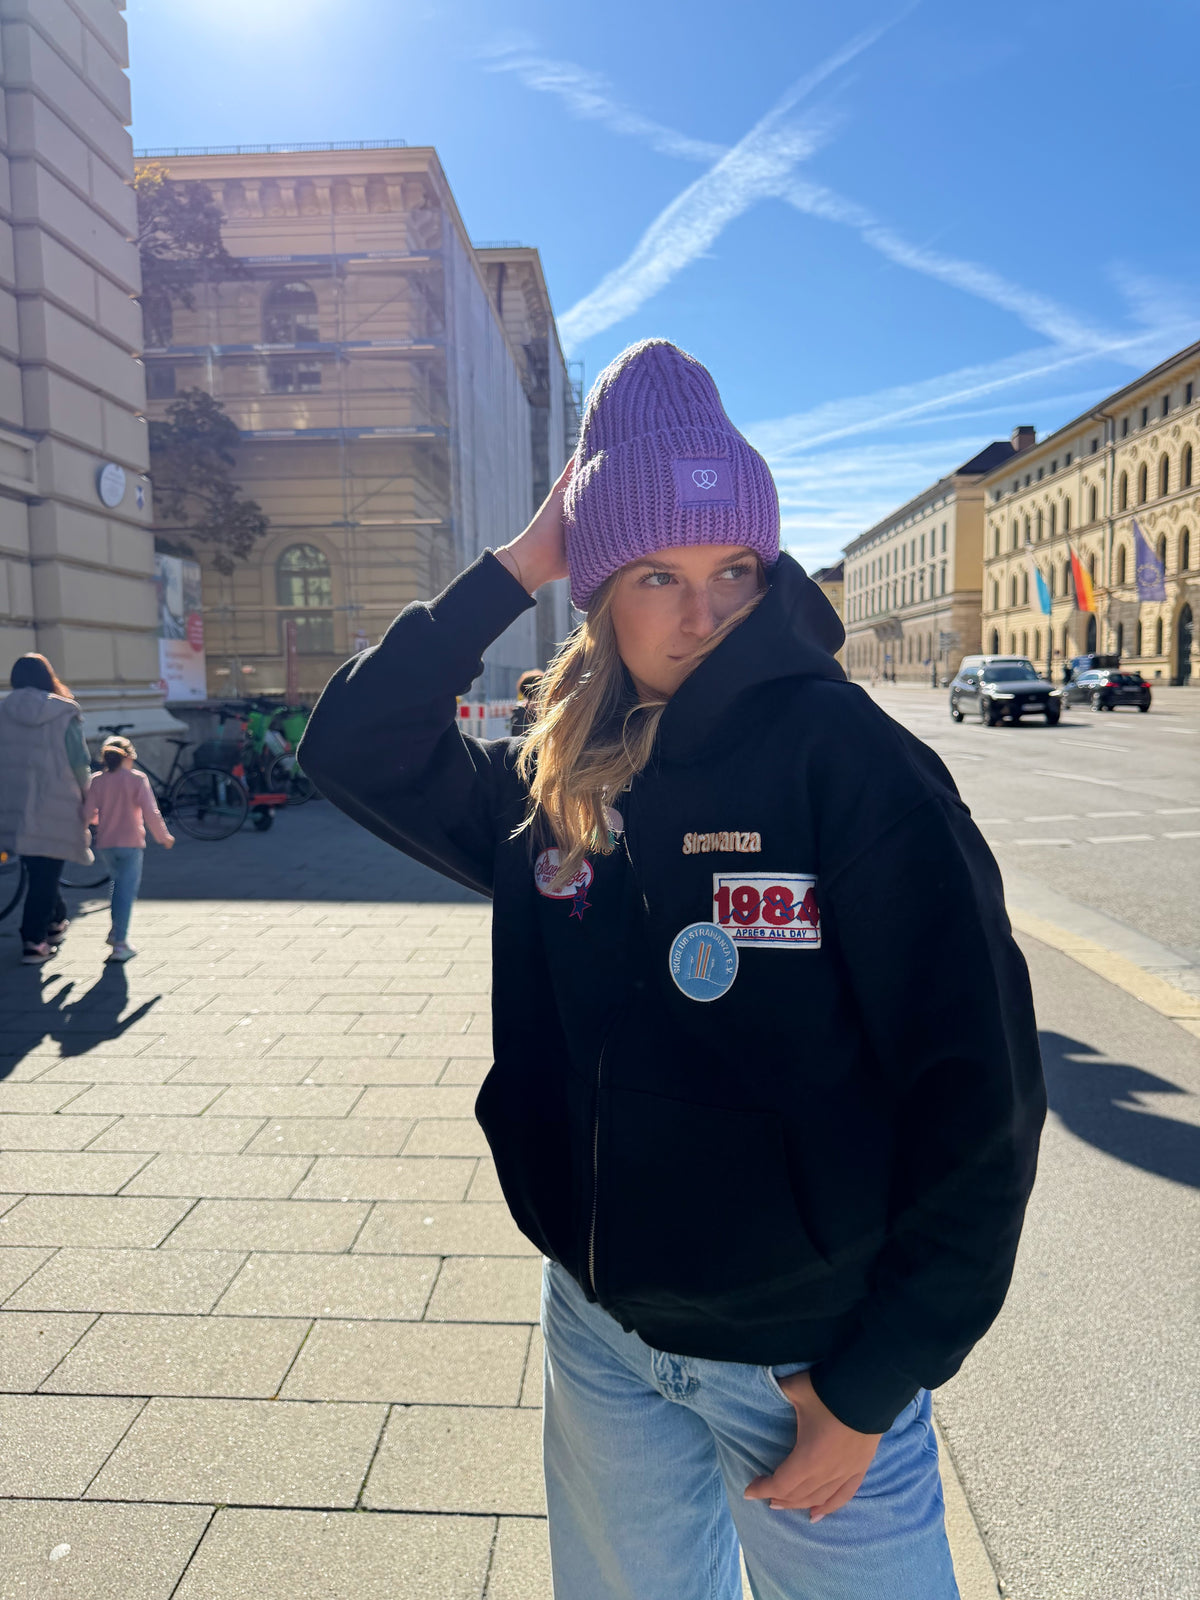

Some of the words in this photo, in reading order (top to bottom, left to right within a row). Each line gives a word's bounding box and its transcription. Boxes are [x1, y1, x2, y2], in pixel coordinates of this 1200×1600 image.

[682, 831, 762, 855] Strawanza
[714, 885, 820, 927] 1984
[769, 929, 787, 938] ALL
[789, 929, 807, 938] DAY
[673, 937, 690, 974] SKICLUB
